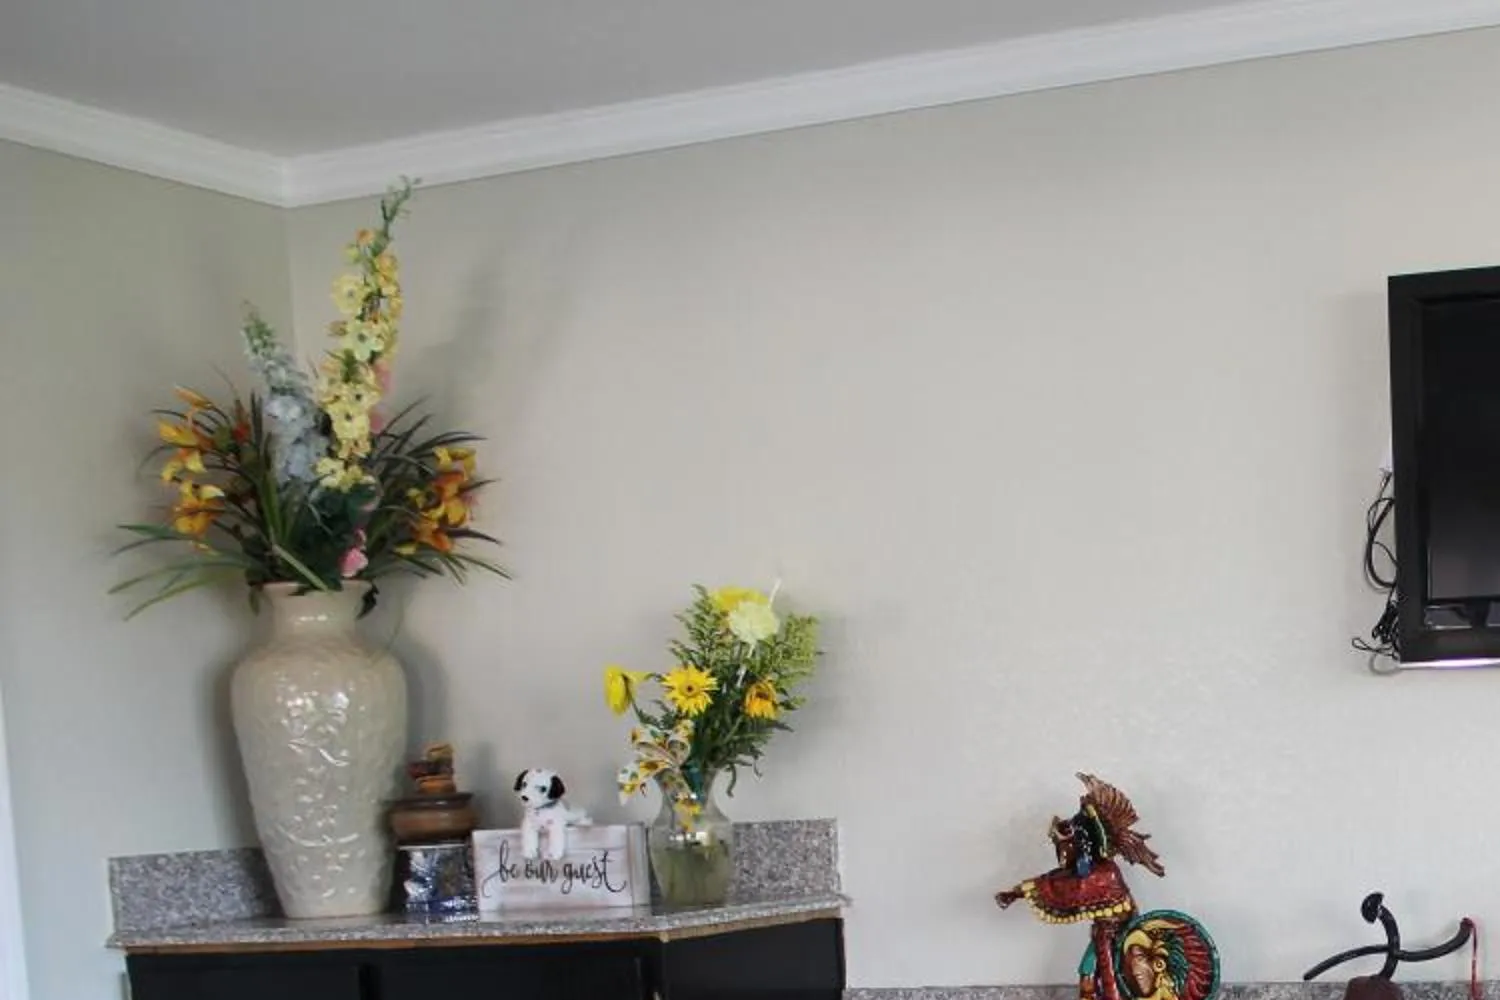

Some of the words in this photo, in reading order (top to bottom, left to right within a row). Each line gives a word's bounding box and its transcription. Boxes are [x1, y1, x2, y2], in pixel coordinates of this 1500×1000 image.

[482, 840, 518, 897] be
[524, 857, 558, 884] our
[561, 850, 627, 894] guest
